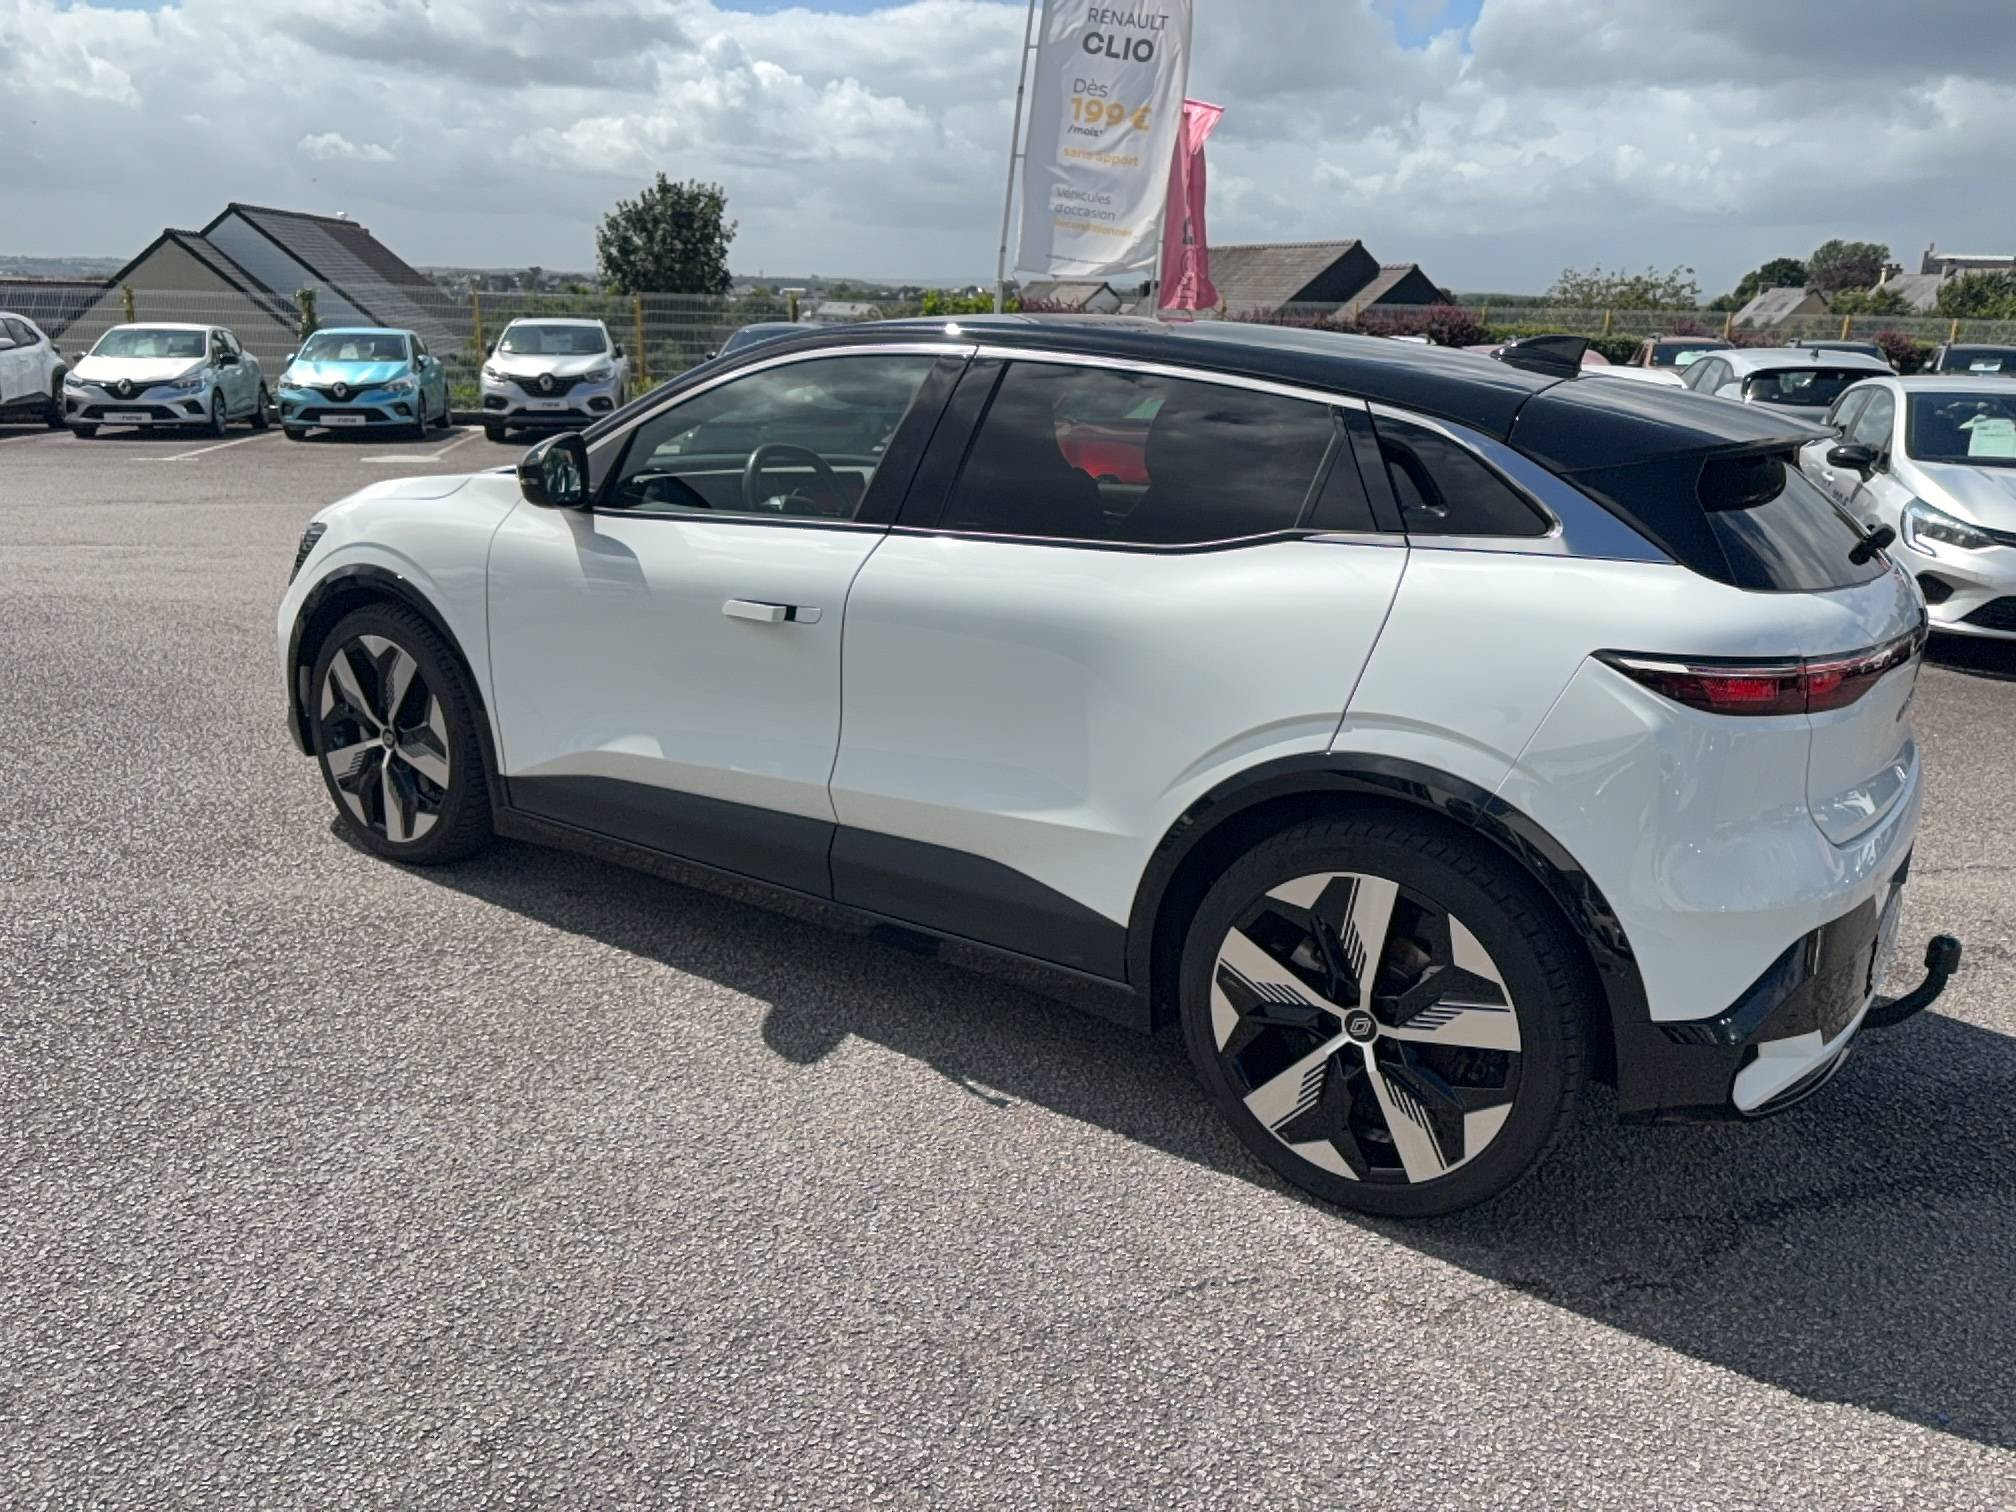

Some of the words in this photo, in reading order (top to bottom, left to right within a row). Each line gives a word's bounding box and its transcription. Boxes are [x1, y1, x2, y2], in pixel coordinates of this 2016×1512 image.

[1087, 7, 1169, 31] RENAULT
[1082, 31, 1155, 63] CLIO
[1072, 77, 1109, 98] Dès
[1071, 97, 1126, 128] 199
